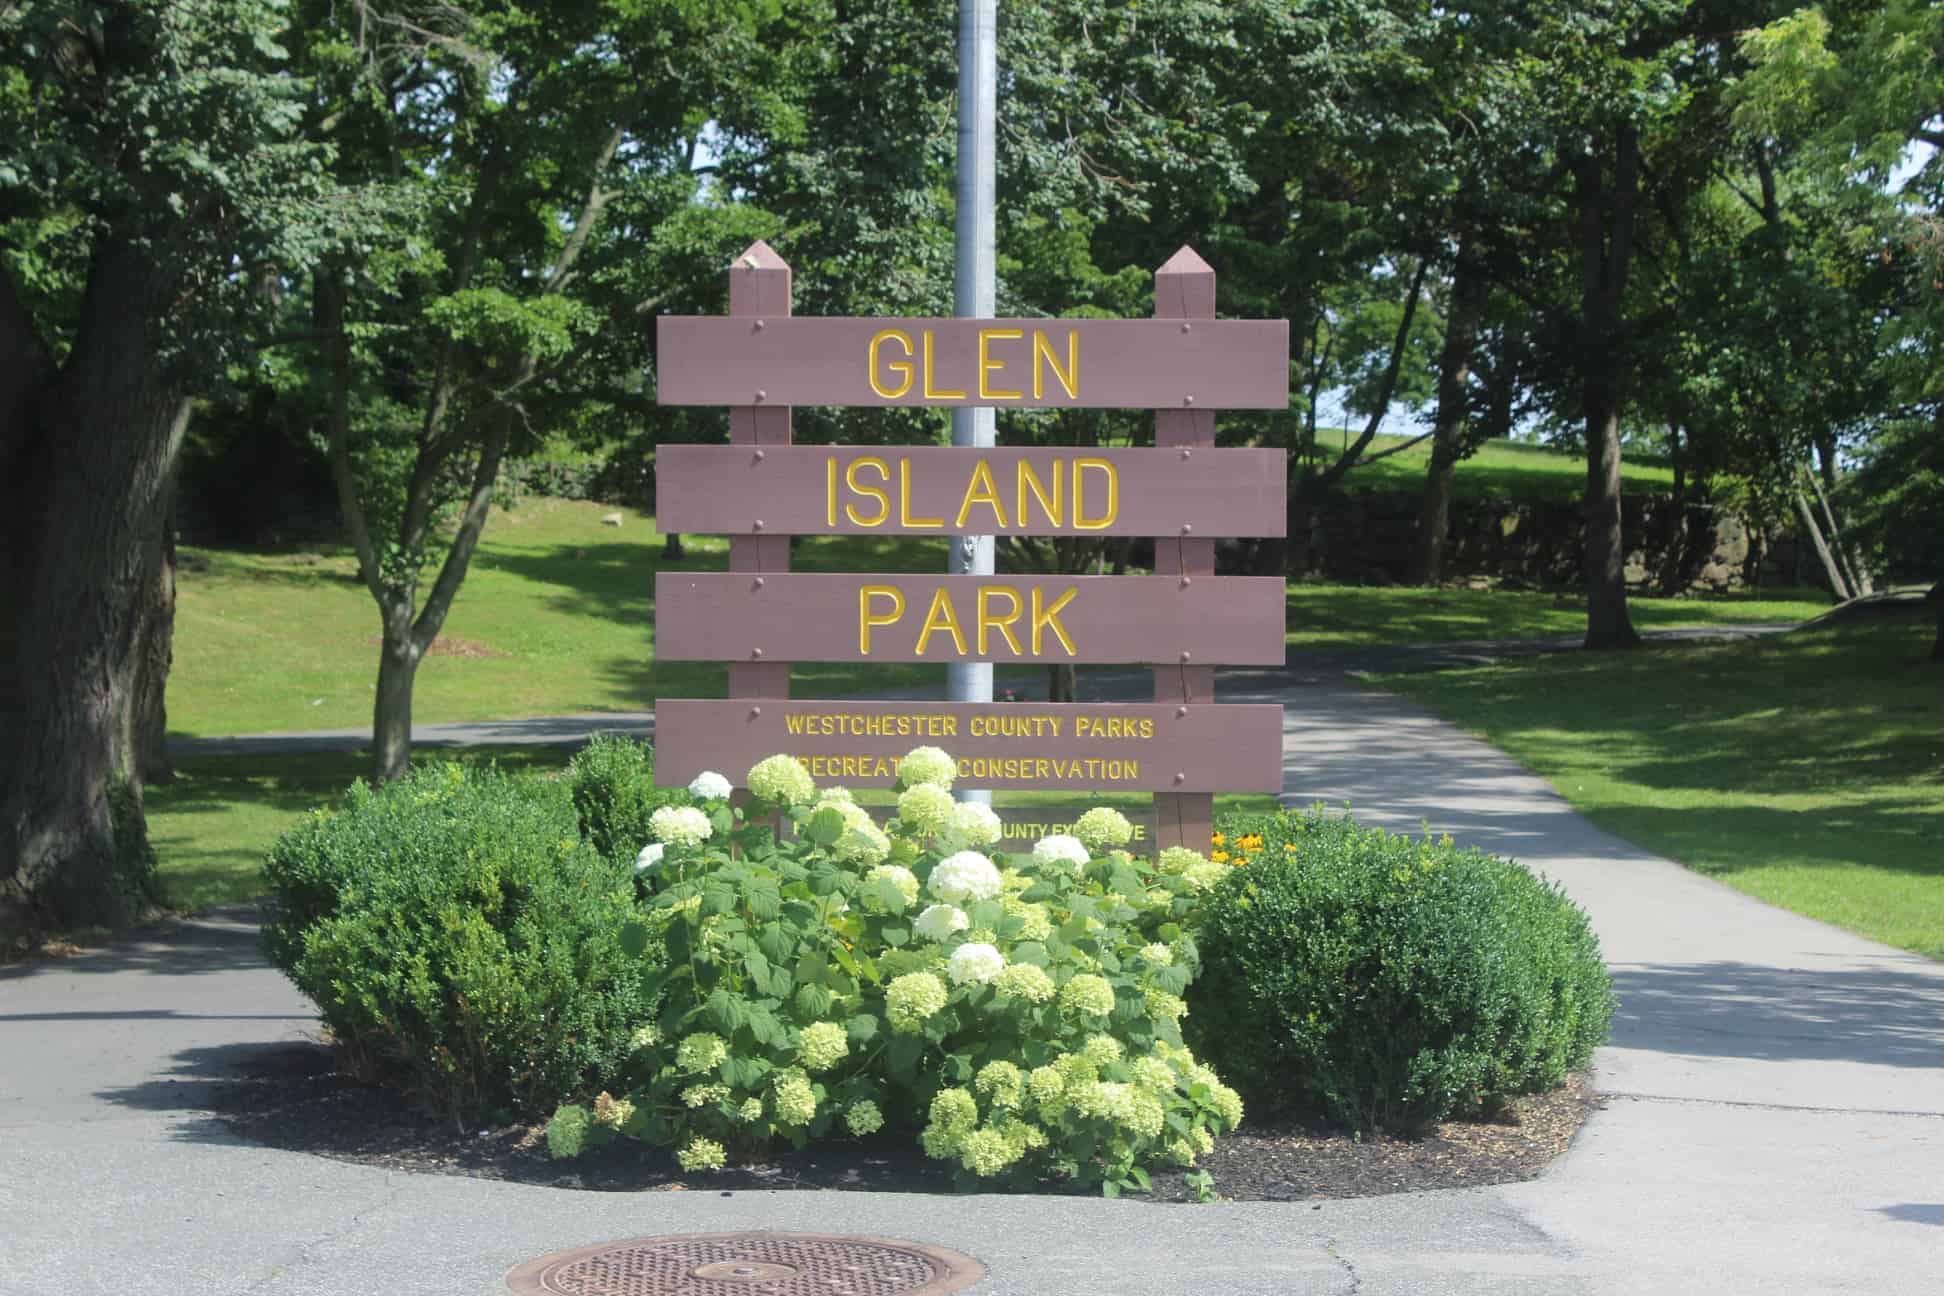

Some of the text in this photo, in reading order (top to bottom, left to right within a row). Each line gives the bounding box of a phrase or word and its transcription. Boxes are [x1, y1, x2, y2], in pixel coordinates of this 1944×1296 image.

[868, 328, 1080, 400] GLEN
[826, 455, 1120, 531] ISLAND
[859, 584, 1078, 656] PARK
[785, 713, 1155, 739] WESTCHESTER COUNTY PARKS
[957, 757, 1139, 781] CONSERVATION
